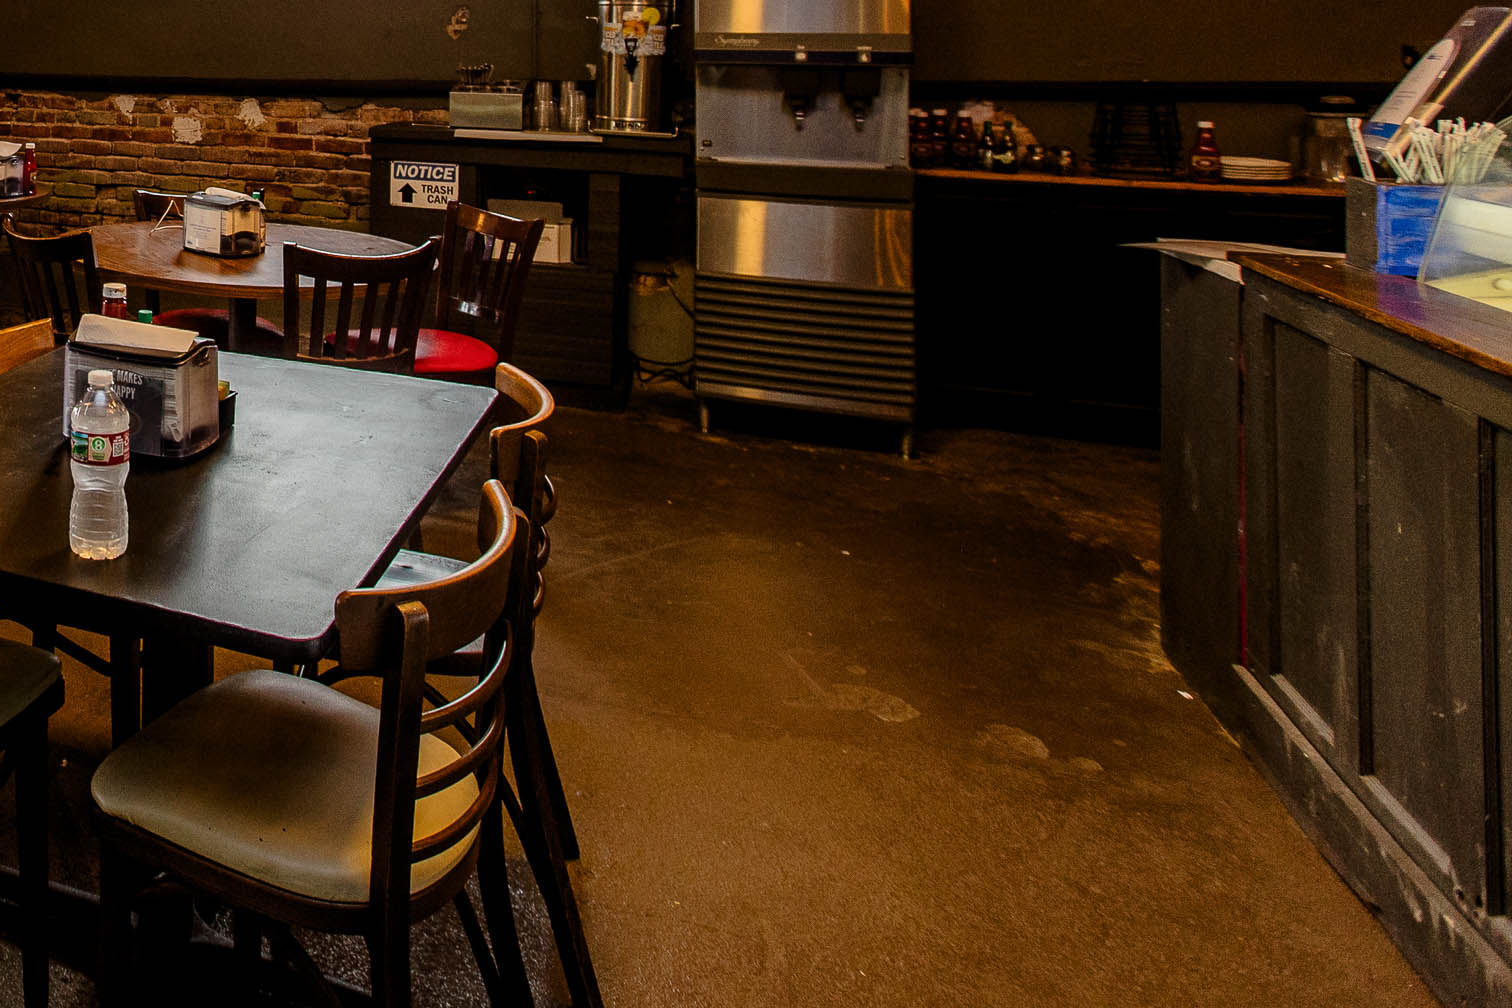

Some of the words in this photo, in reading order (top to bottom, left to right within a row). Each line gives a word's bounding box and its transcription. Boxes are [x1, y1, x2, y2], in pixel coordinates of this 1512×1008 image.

[396, 164, 455, 180] NOTICE
[422, 184, 454, 195] TRASH
[427, 195, 448, 204] CAN
[116, 369, 143, 385] MAKES
